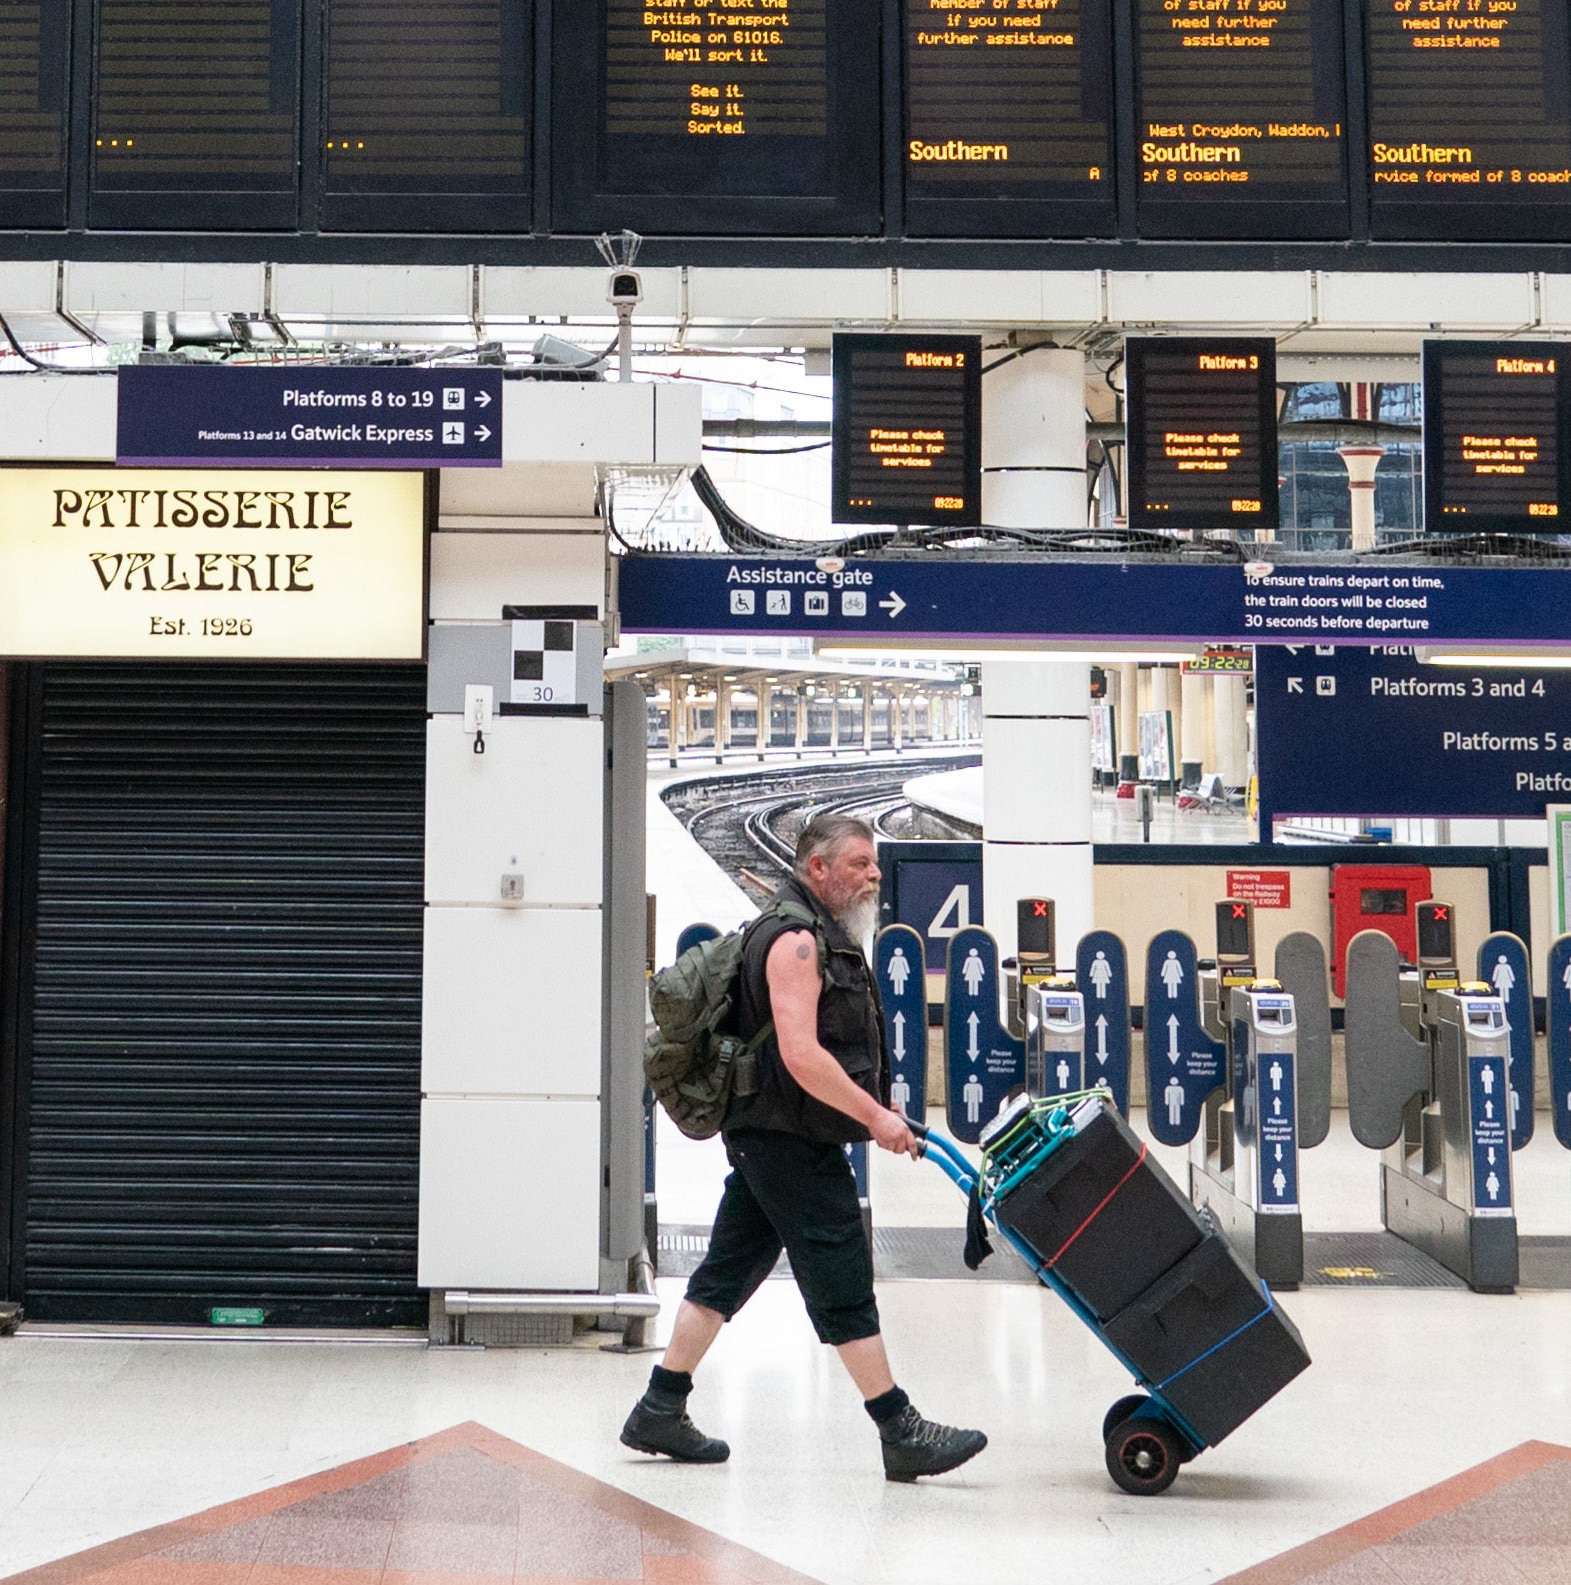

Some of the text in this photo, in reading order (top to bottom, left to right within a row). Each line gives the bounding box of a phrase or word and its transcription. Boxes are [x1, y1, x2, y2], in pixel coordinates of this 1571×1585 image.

[642, 11, 790, 28] British Transport
[650, 29, 784, 45] Police on 61016.
[664, 47, 769, 63] We'll sort it.
[689, 83, 745, 99] See it.
[690, 101, 745, 118] Say it.
[687, 119, 746, 135] Sorted.
[909, 140, 1008, 161] Southern
[905, 352, 965, 367] Platform 2
[1496, 358, 1556, 373] Platform 4
[284, 390, 433, 407] Platforms 8 to 19
[199, 431, 286, 440] Platforms 13 and 14
[291, 424, 433, 444] Gatwick Express
[869, 429, 945, 441] Please check
[925, 443, 945, 454] for
[880, 456, 933, 467] services
[53, 490, 352, 528] PATISSERIE
[89, 553, 313, 591] VALERIE
[726, 566, 873, 589] Assistance gate
[1245, 575, 1444, 589] To ensure trains depart on time,
[1245, 595, 1426, 608] the train doors will be closed
[150, 617, 252, 635] Est. 1926
[1246, 615, 1428, 631] 30 seconds before departure
[534, 687, 553, 701] 30
[1372, 678, 1545, 696] Platforms 3 and 4
